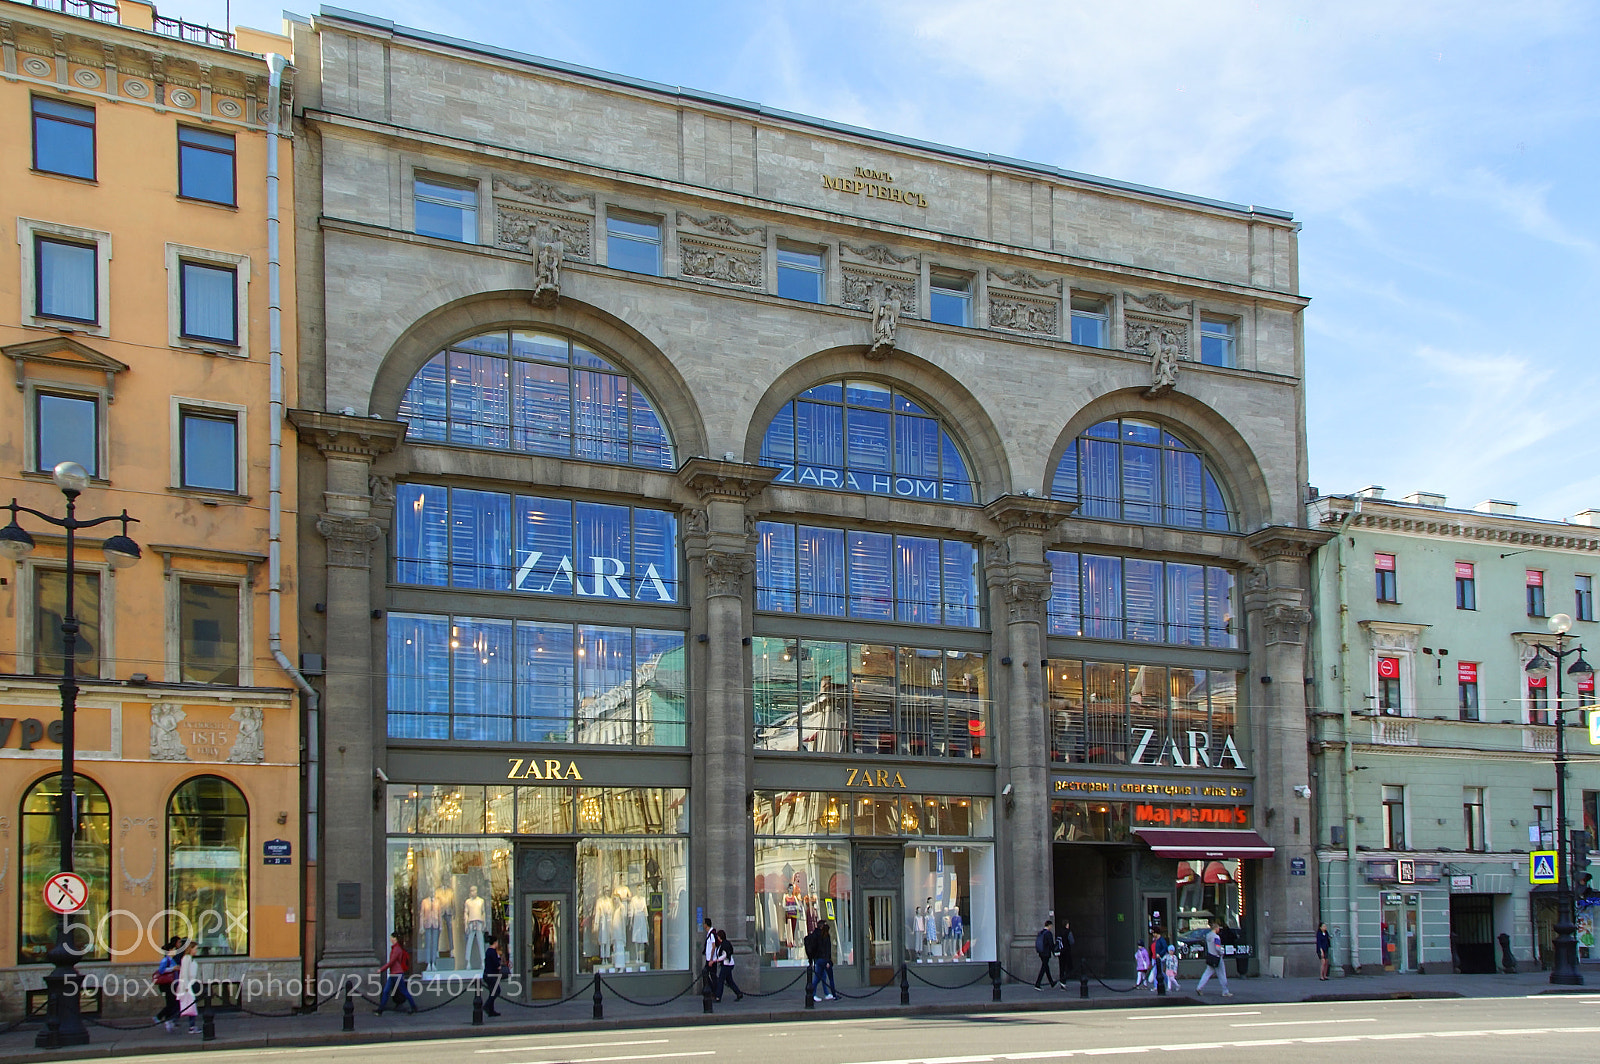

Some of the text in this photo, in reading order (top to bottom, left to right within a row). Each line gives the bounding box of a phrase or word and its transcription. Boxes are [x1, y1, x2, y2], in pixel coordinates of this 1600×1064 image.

[854, 166, 893, 182] ДОМЪ
[823, 174, 929, 208] МЕРТЕНСЪ
[778, 464, 955, 501] ZARA HOME
[507, 549, 676, 602] ZARA
[191, 731, 228, 745] 1815
[1130, 727, 1247, 769] ZARA
[507, 758, 583, 781] ZARA
[846, 768, 907, 788] ZARA
[1054, 780, 1110, 793] ресторан
[1202, 785, 1227, 797] wine
[1230, 786, 1248, 797] bar
